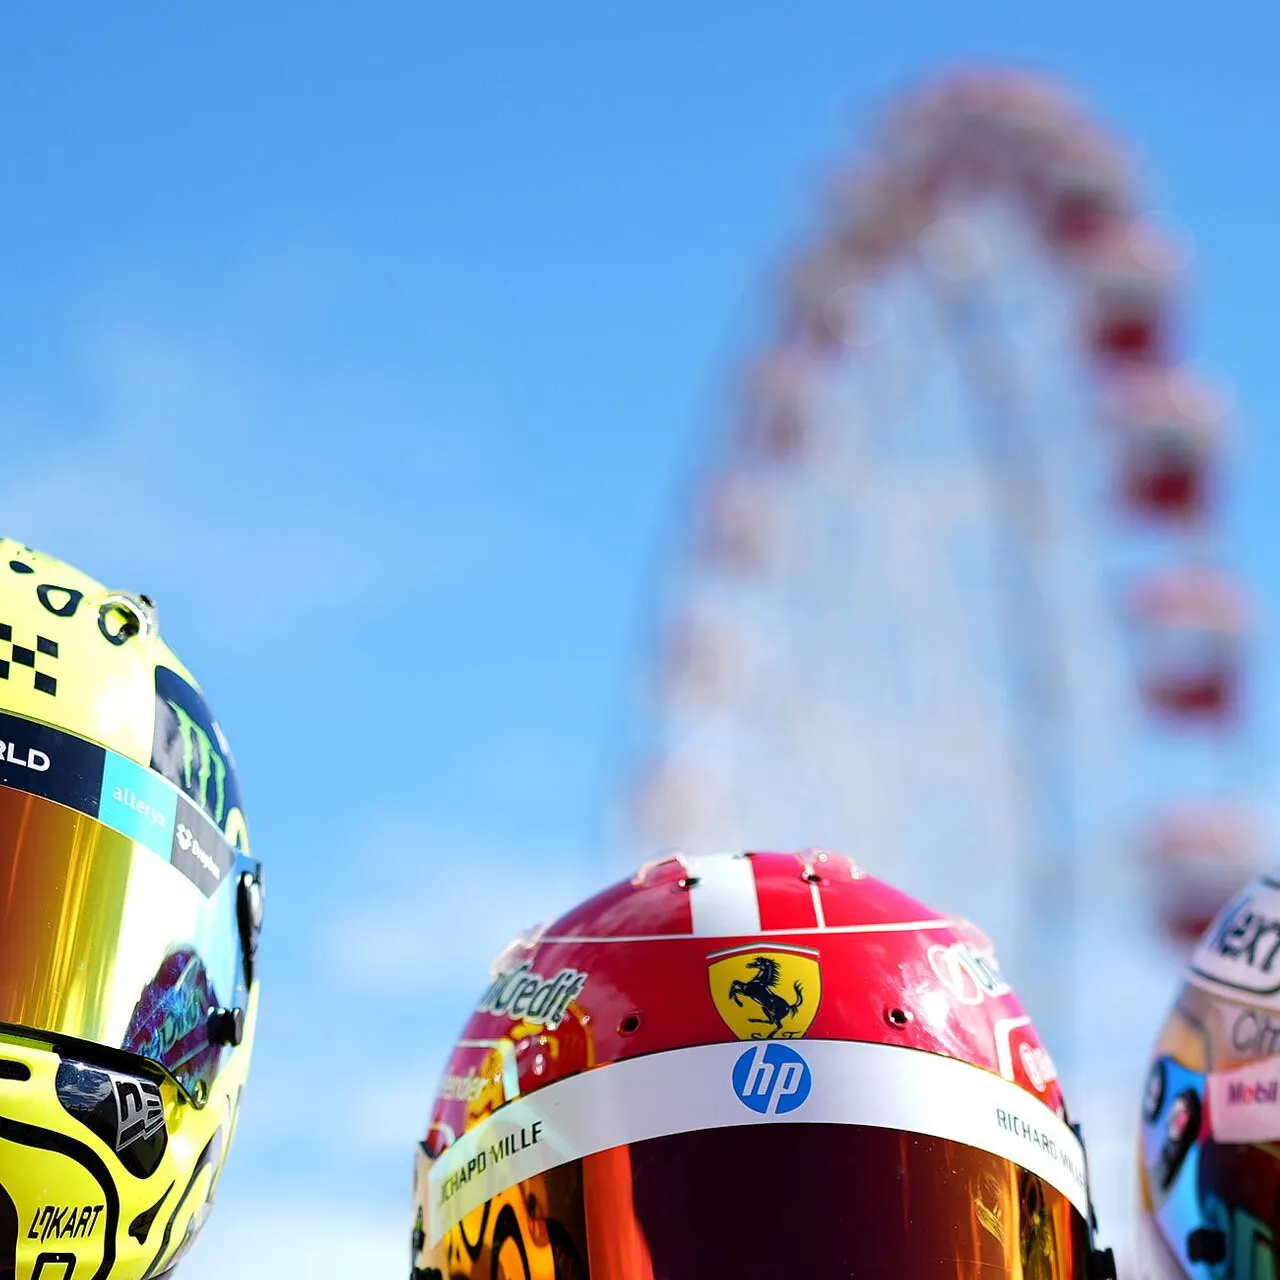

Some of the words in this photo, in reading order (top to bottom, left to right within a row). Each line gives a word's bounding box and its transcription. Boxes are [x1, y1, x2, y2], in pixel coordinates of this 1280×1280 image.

[112, 786, 167, 829] alteryx
[739, 1042, 806, 1116] hp
[996, 1108, 1057, 1160] RICHARD
